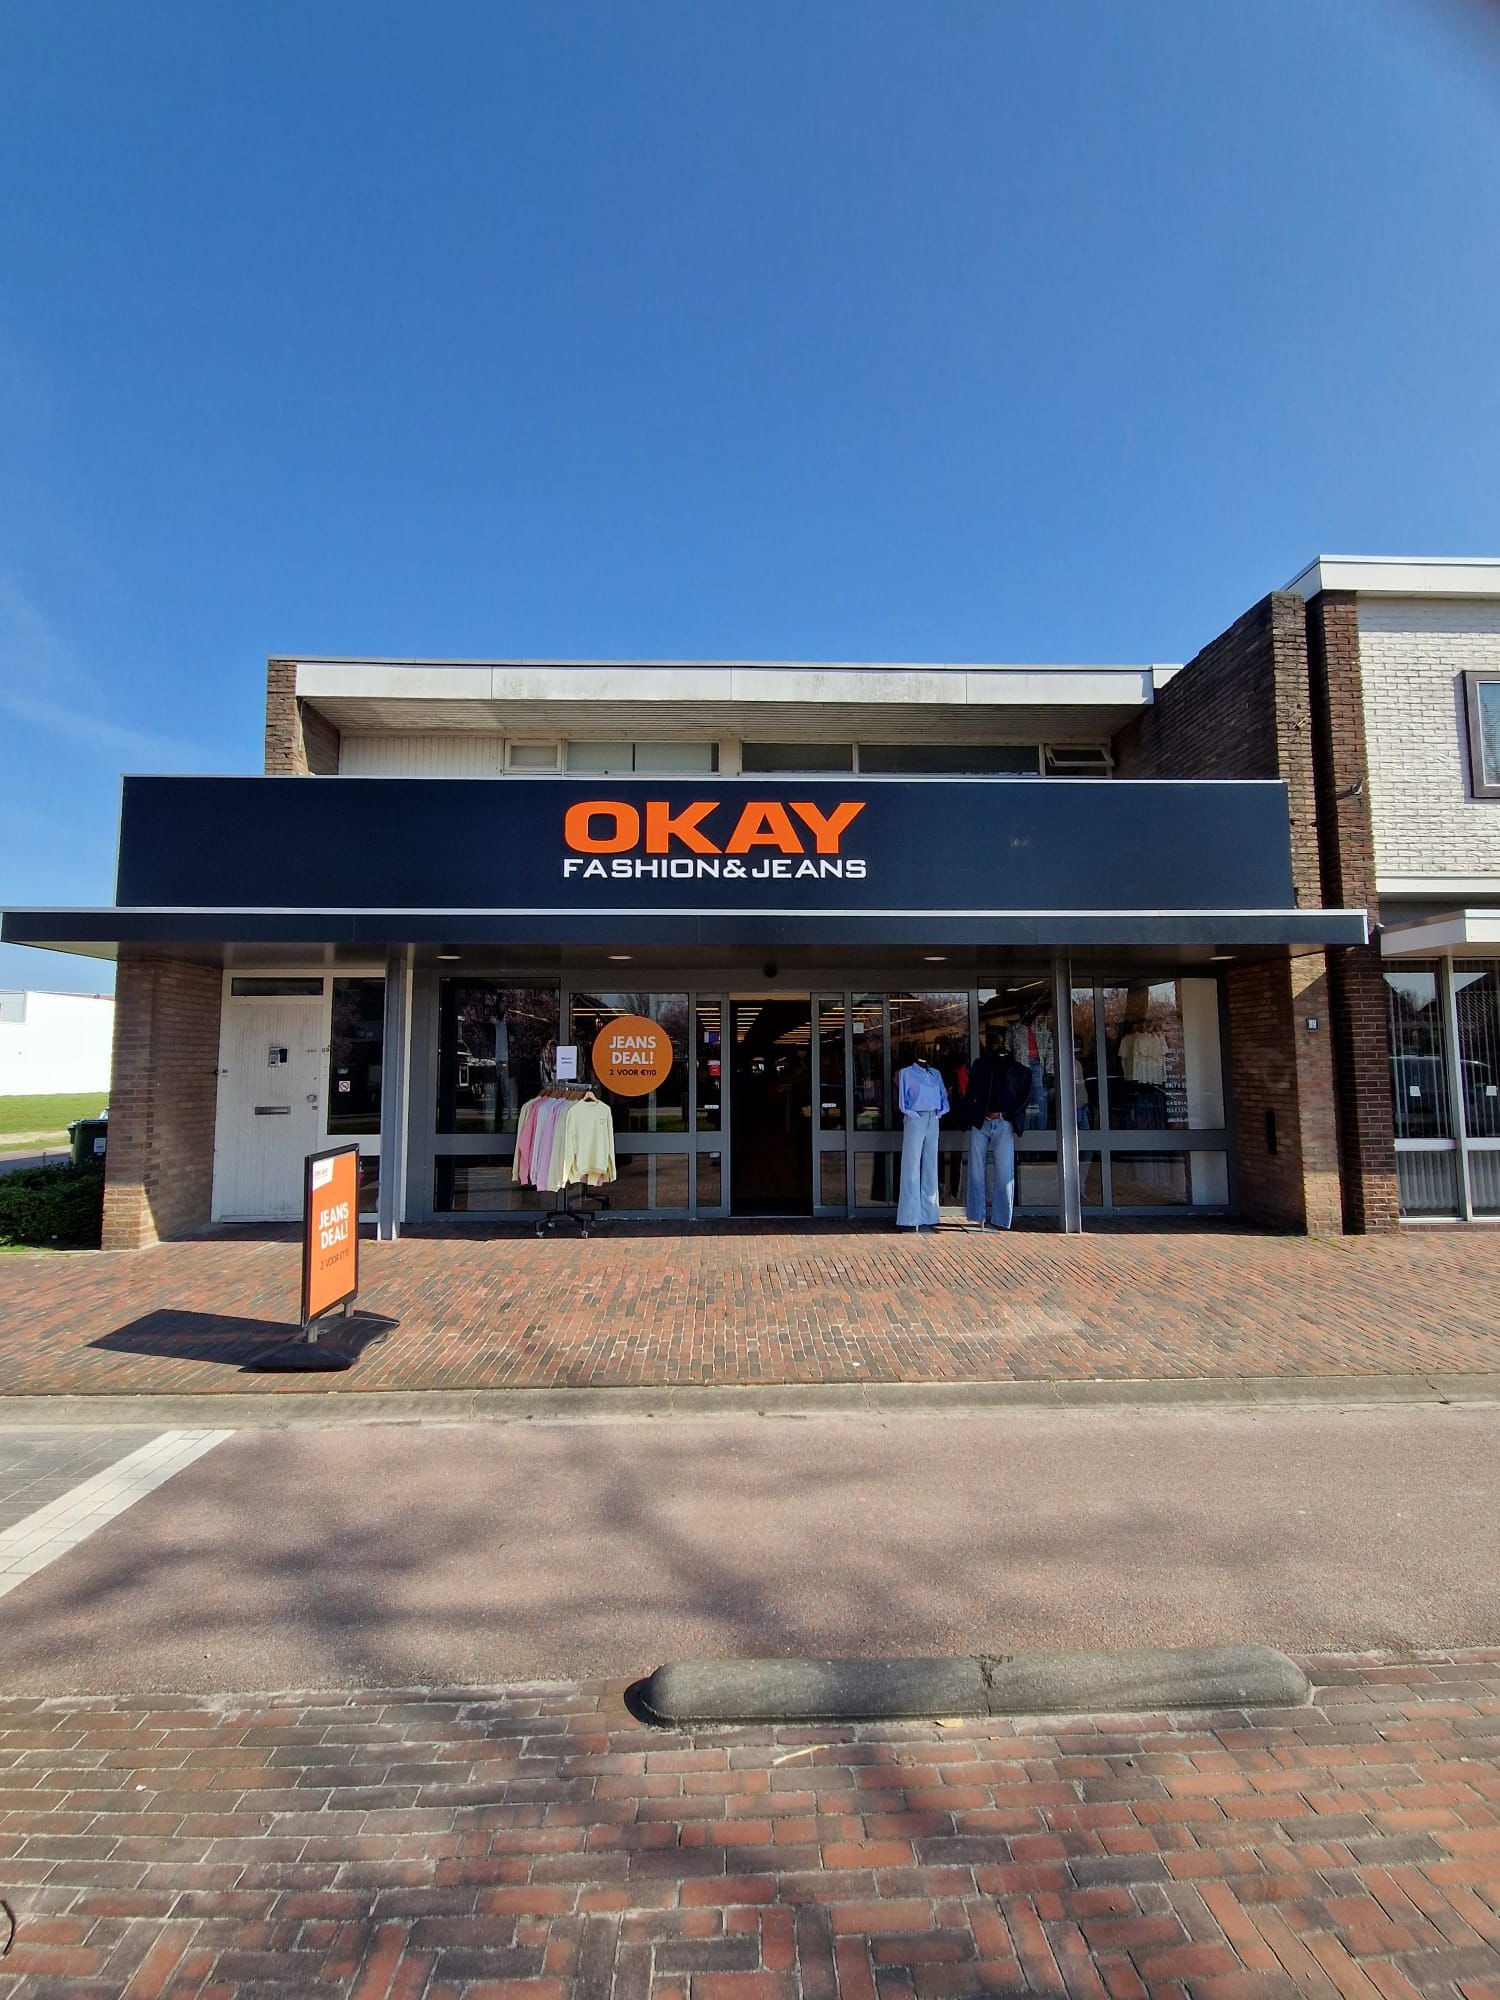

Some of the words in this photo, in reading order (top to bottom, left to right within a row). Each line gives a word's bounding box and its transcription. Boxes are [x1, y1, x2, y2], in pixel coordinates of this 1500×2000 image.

[564, 801, 867, 854] OKAY
[563, 858, 867, 879] FASHION&JEANS
[609, 1036, 656, 1048] JEANS
[612, 1052, 653, 1064] DEAL!
[319, 1202, 349, 1230] JEANS
[321, 1221, 348, 1249] DEAL!
